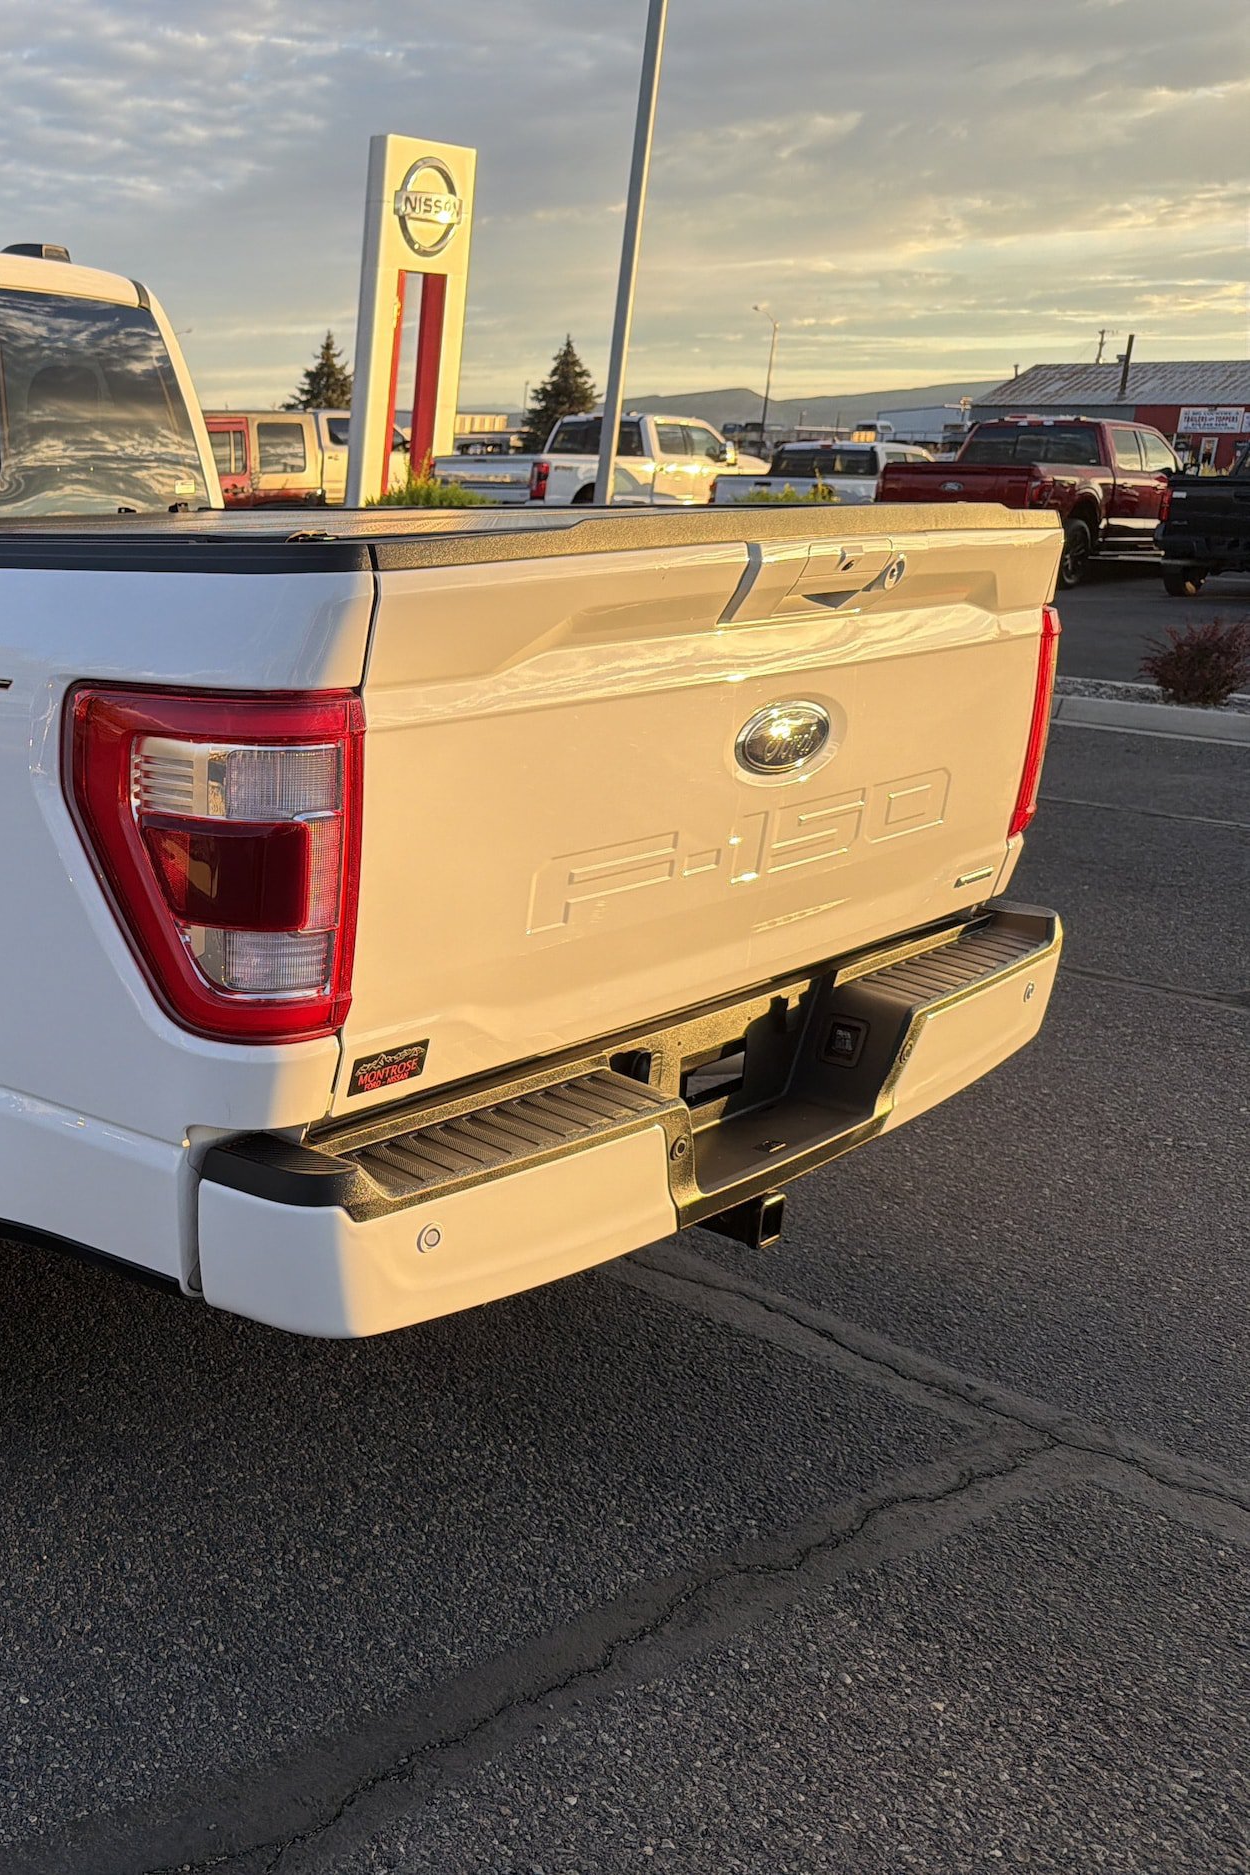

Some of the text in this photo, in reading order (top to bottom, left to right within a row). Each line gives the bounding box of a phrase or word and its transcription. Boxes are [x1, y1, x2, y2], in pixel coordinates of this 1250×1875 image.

[403, 195, 460, 218] NISSAN
[527, 767, 952, 935] F-150
[358, 1058, 419, 1086] MONTROSE
[364, 1081, 382, 1091] FORD
[386, 1071, 410, 1085] NISSAN
